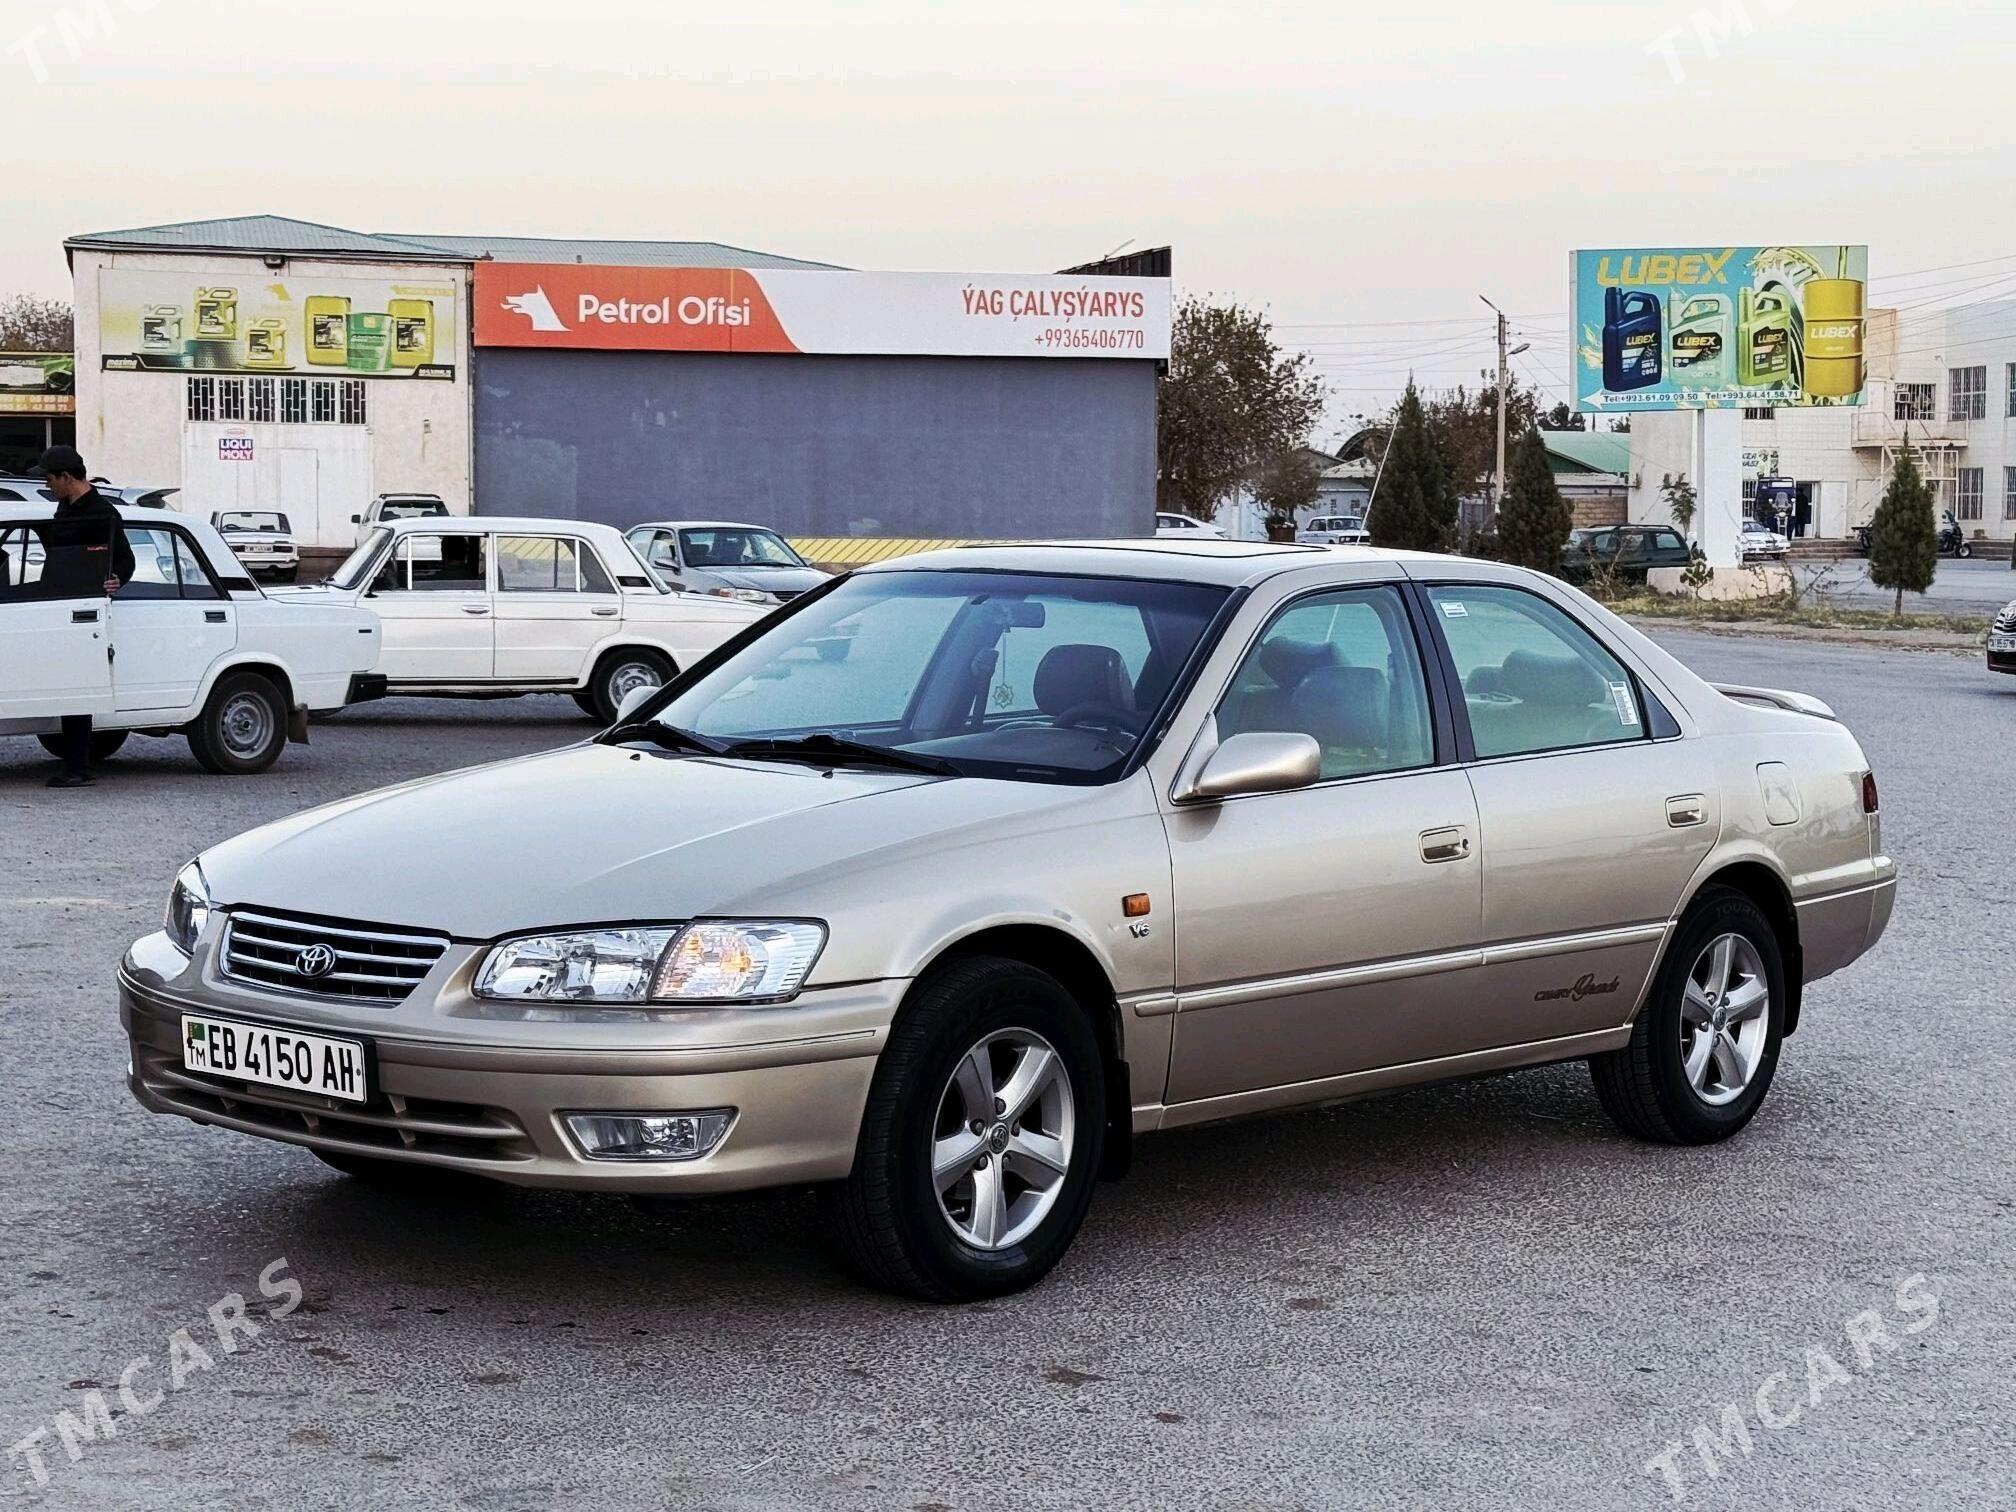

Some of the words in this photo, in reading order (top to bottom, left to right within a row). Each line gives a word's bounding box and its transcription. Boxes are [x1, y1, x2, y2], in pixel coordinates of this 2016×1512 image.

[1597, 247, 1736, 286] LUBEX
[578, 294, 670, 324] Petrol
[678, 296, 750, 326] Ofisi
[962, 283, 1003, 316] ÝAG
[1010, 285, 1145, 322] ÇALYŞÝARYS
[1034, 329, 1144, 349] +99365406770
[1626, 332, 1656, 346] LUBEX
[1757, 331, 1785, 344] LUBEX
[1811, 325, 1858, 339] LUBEX
[1677, 336, 1717, 346] LUBEX
[220, 439, 253, 449] LIQUI
[220, 450, 253, 460] MOLY
[1128, 922, 1150, 939] V6
[189, 1045, 206, 1067] TM
[208, 1024, 238, 1071] EB
[244, 1031, 313, 1085] 4150
[322, 1045, 355, 1094] AH
